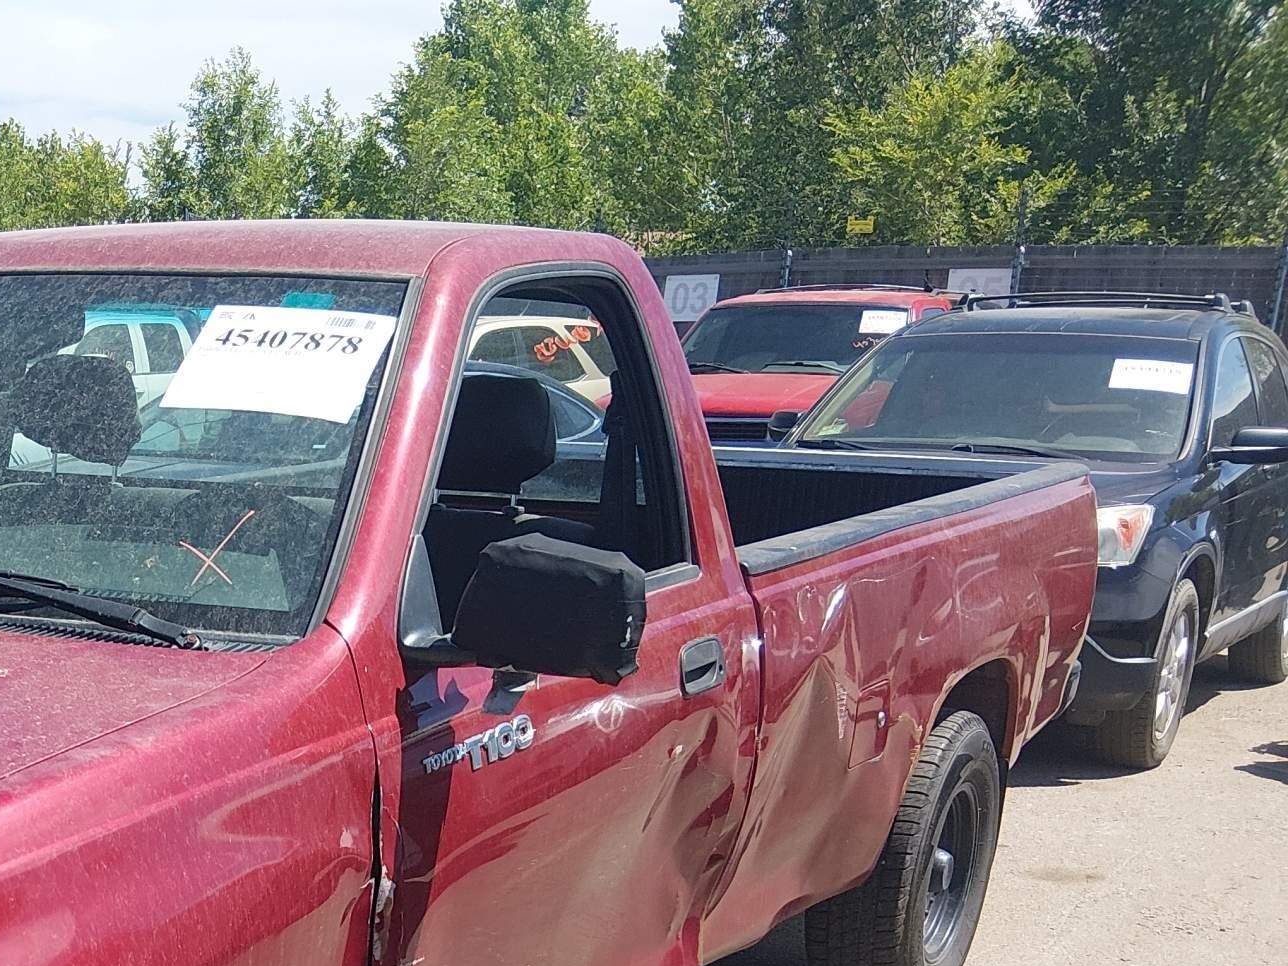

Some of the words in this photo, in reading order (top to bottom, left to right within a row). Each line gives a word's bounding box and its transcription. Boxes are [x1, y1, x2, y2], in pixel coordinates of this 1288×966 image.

[672, 282, 708, 314] 03
[215, 327, 364, 355] 45407878
[422, 743, 468, 774] TOYOTA
[464, 714, 537, 772] T100
